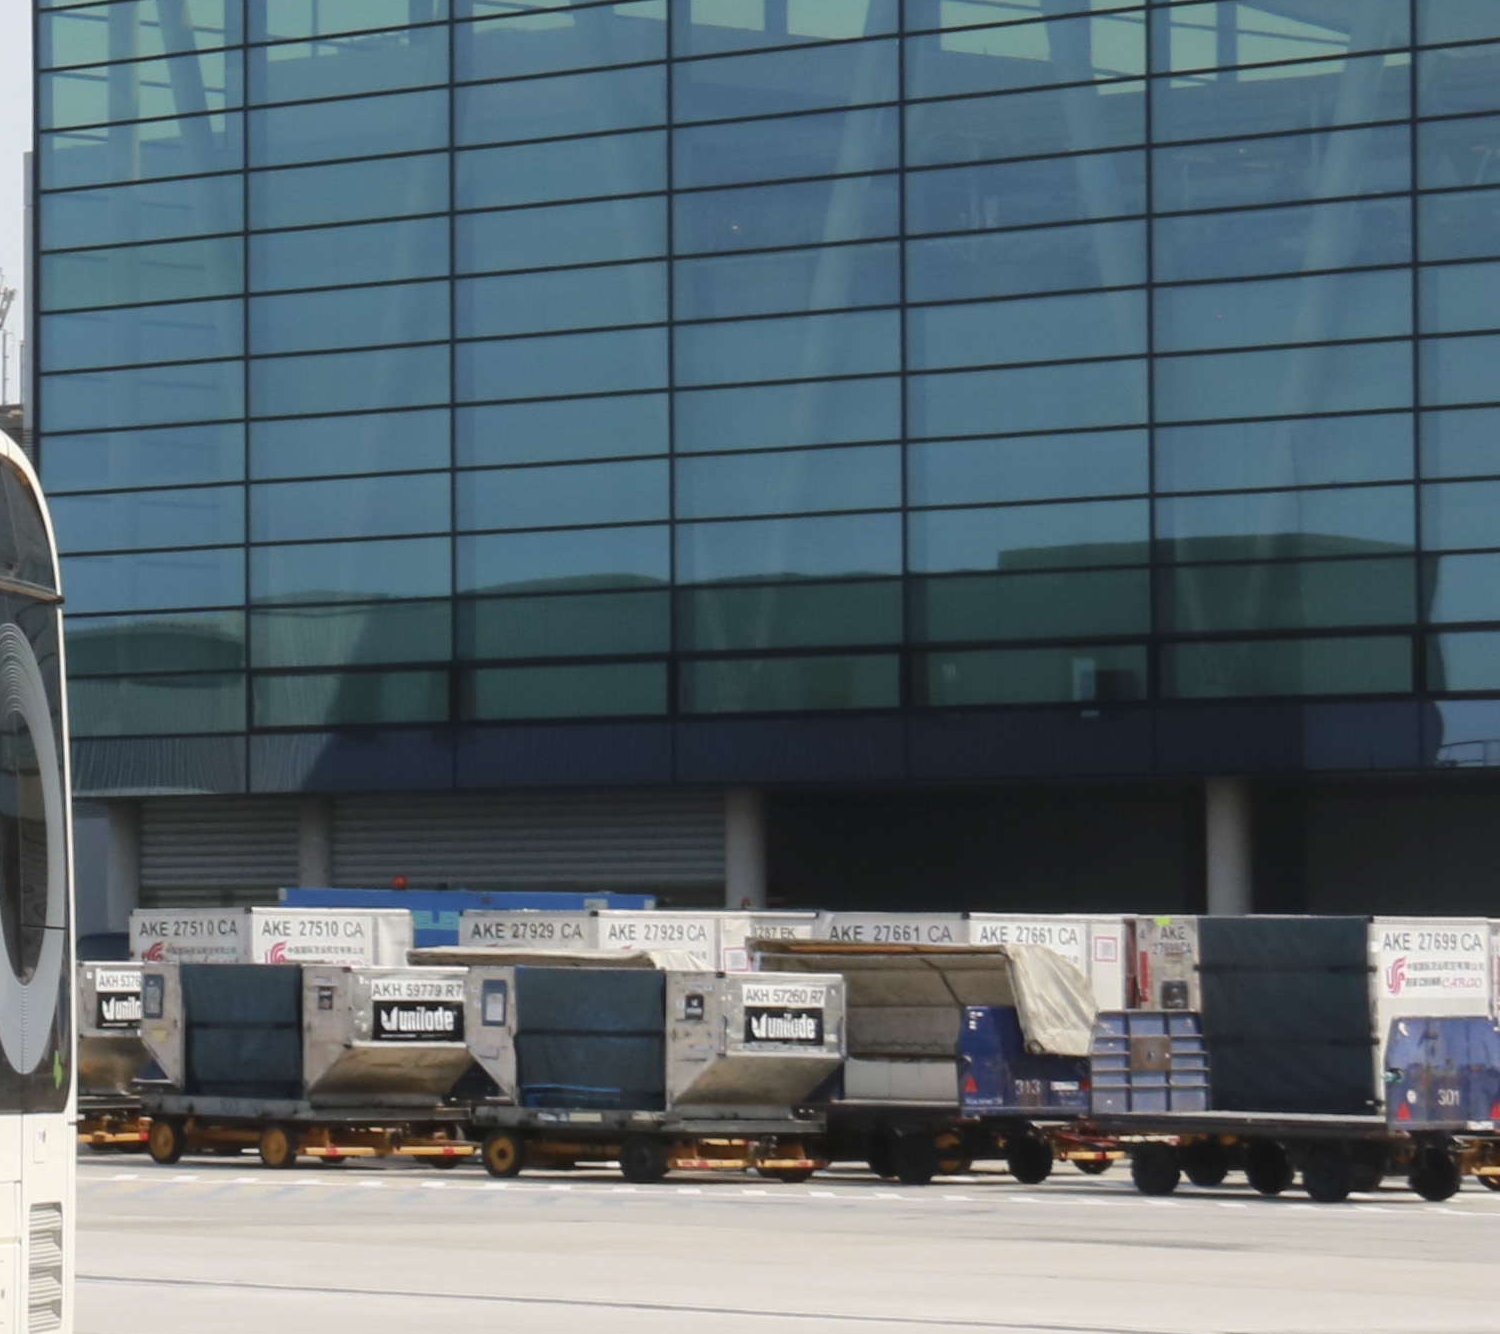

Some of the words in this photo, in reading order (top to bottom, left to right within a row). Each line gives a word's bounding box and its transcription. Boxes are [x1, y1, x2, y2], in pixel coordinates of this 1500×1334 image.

[139, 920, 168, 937] AKE
[173, 920, 214, 936] 27510
[218, 919, 238, 935] CA
[261, 920, 292, 937] AKE
[299, 920, 339, 937] 27510
[343, 920, 364, 938] CA
[471, 923, 506, 939] AKE
[512, 923, 555, 940] 27929
[560, 923, 583, 939] CA
[608, 924, 637, 940] AKE
[644, 924, 684, 941] 27929
[686, 924, 707, 941] CA
[829, 925, 863, 941] AKE
[873, 925, 921, 941] 27661
[927, 925, 953, 942] CA
[979, 925, 1008, 942] AKE
[1016, 926, 1053, 944] 27661
[1058, 927, 1079, 945] CA
[1160, 927, 1186, 940] AKE
[1383, 932, 1411, 951] AKE
[1418, 932, 1457, 951] 27699
[1461, 932, 1483, 951] CA
[100, 975, 119, 987] AKH
[372, 984, 401, 997] AKH
[406, 984, 440, 997] 59779
[445, 984, 463, 997] R7
[745, 988, 769, 1002] AKH
[772, 988, 807, 1003] 57260
[399, 1006, 455, 1031] unilode
[768, 1013, 816, 1039] unilode
[1015, 1079, 1041, 1095] 313
[1438, 1089, 1460, 1105] 301
